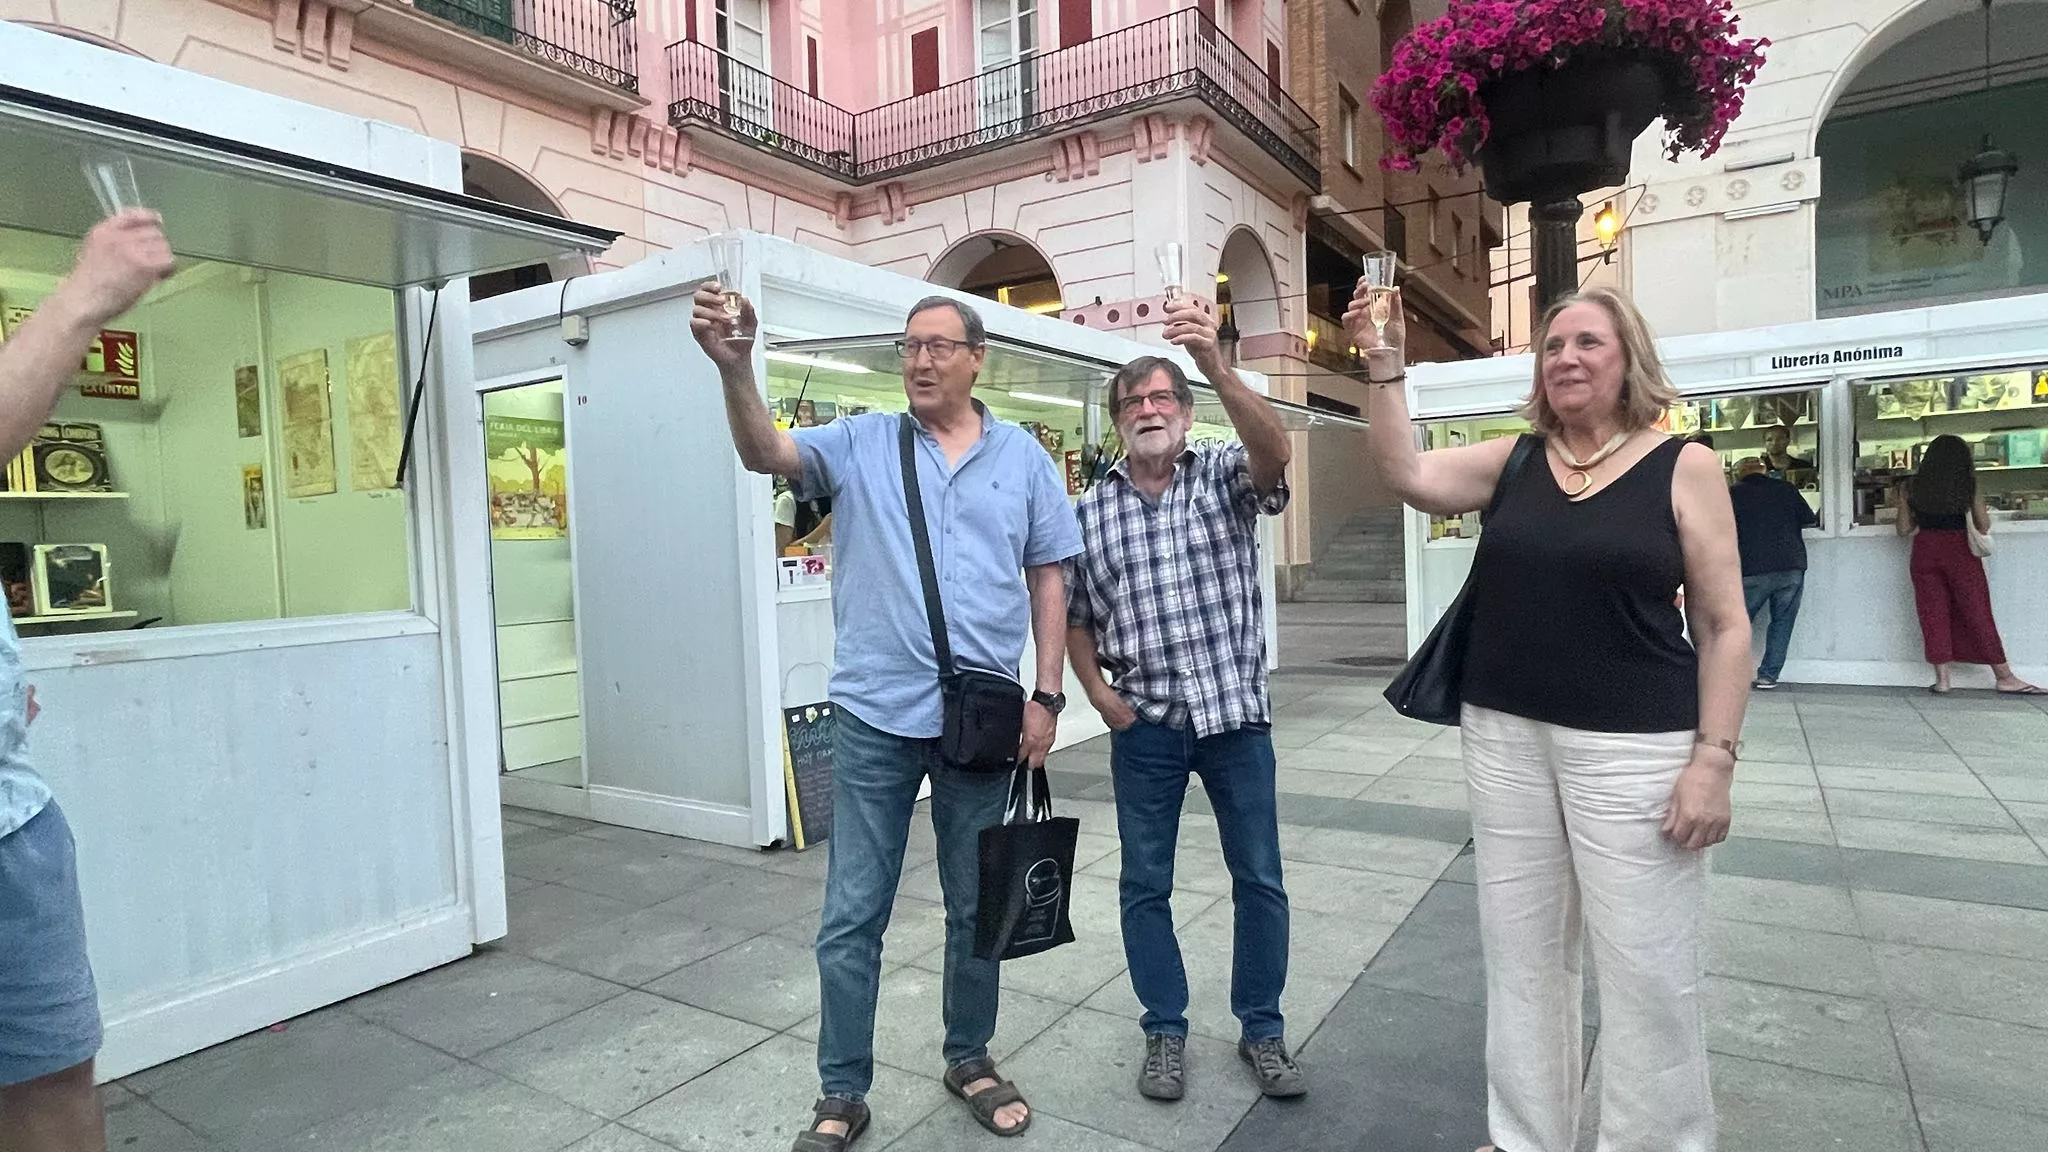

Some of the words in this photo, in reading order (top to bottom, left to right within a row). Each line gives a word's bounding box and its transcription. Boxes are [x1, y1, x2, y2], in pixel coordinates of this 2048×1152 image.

[1823, 285, 1863, 299] MPA
[1772, 351, 1829, 369] Librería
[1833, 346, 1903, 363] Anónima
[82, 384, 137, 396] EXTINTOR
[578, 395, 587, 406] 10
